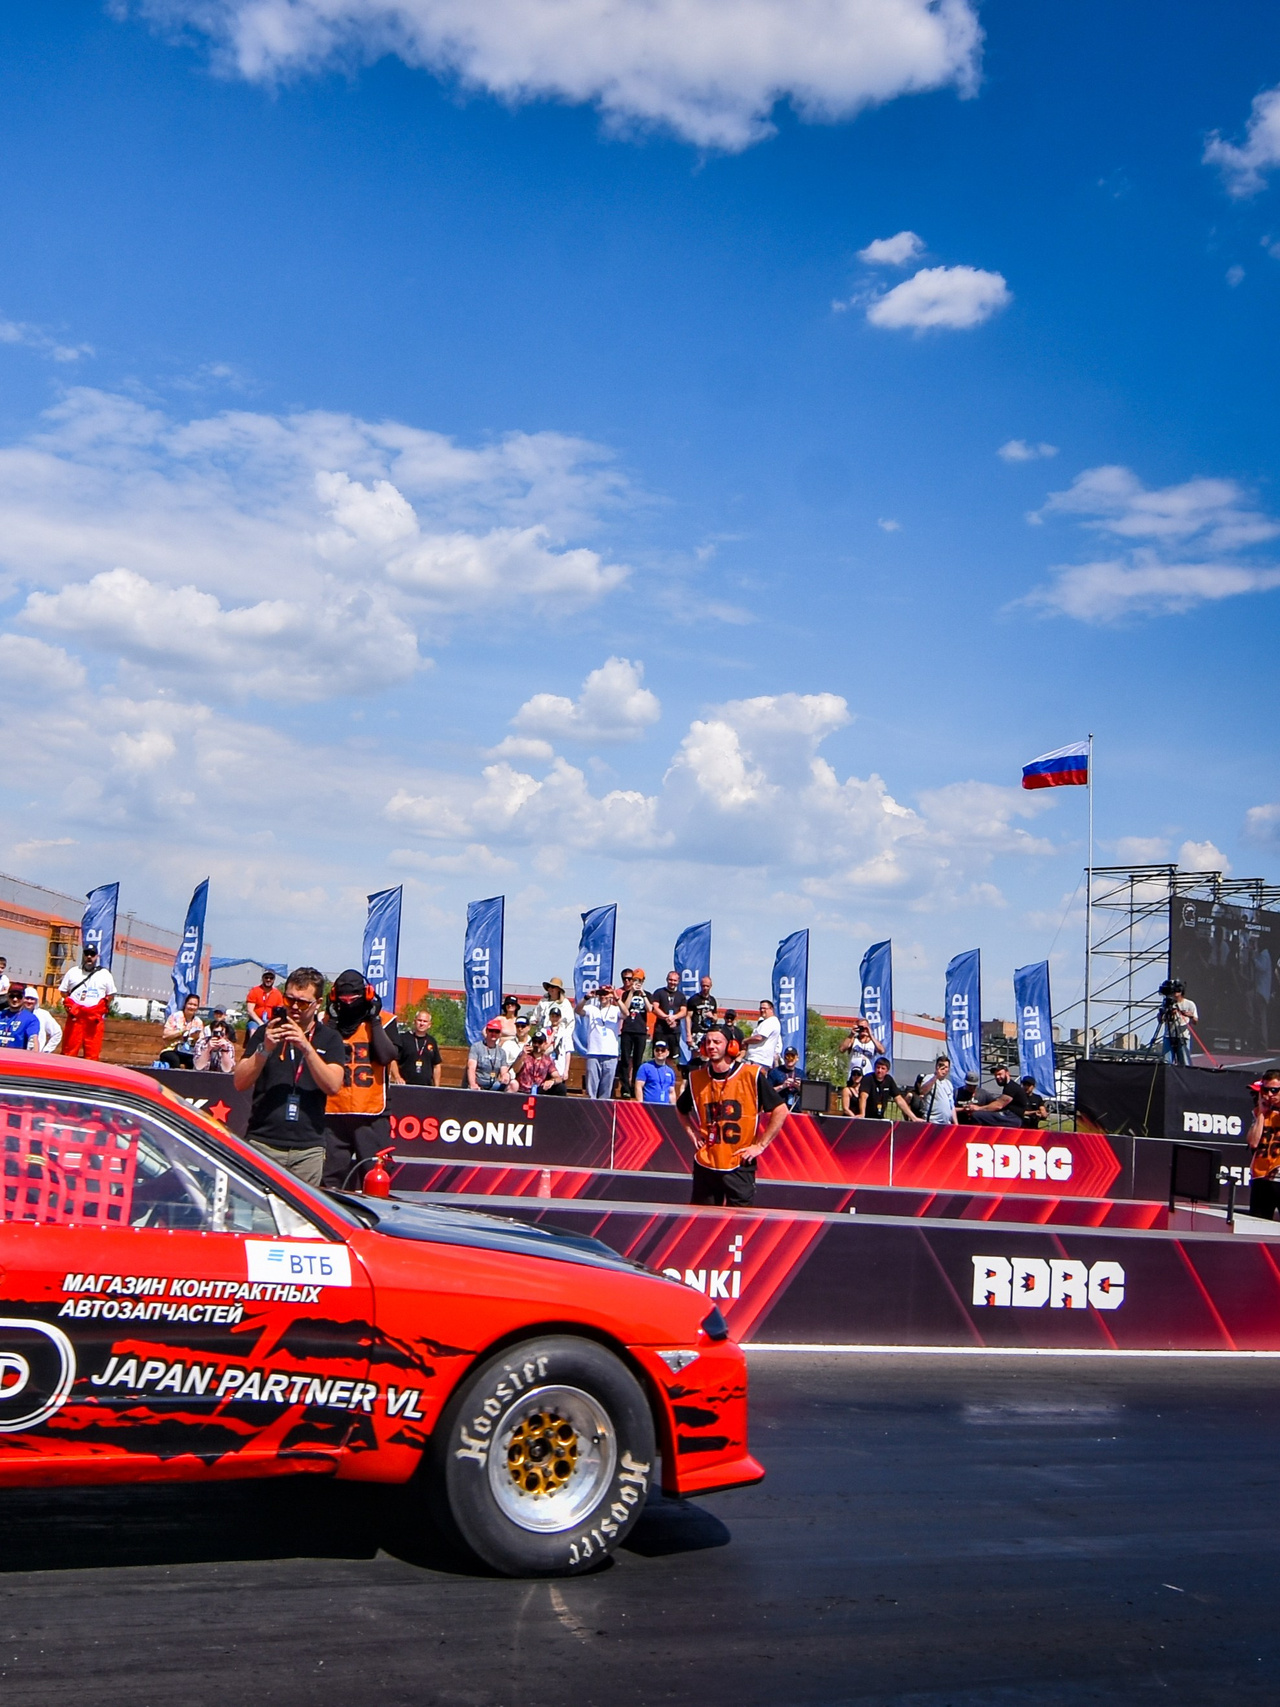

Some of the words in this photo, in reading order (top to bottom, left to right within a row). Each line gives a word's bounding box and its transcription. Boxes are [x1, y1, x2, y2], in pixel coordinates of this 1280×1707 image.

[1183, 1111, 1241, 1136] RDRC
[966, 1142, 1073, 1181] RDRC
[290, 1254, 334, 1277] ВТБ
[972, 1255, 1125, 1310] RDRC
[62, 1273, 168, 1297] МАГАЗИН
[169, 1278, 324, 1304] КОНТРАКТНЫХ
[58, 1298, 245, 1325] АВТОЗАПЧАСТЕЙ
[90, 1356, 215, 1396] JAPAN
[215, 1369, 378, 1412] PARTNER
[386, 1386, 424, 1419] VL
[455, 1355, 549, 1468] Hoosier
[569, 1450, 651, 1566] Hoosier
